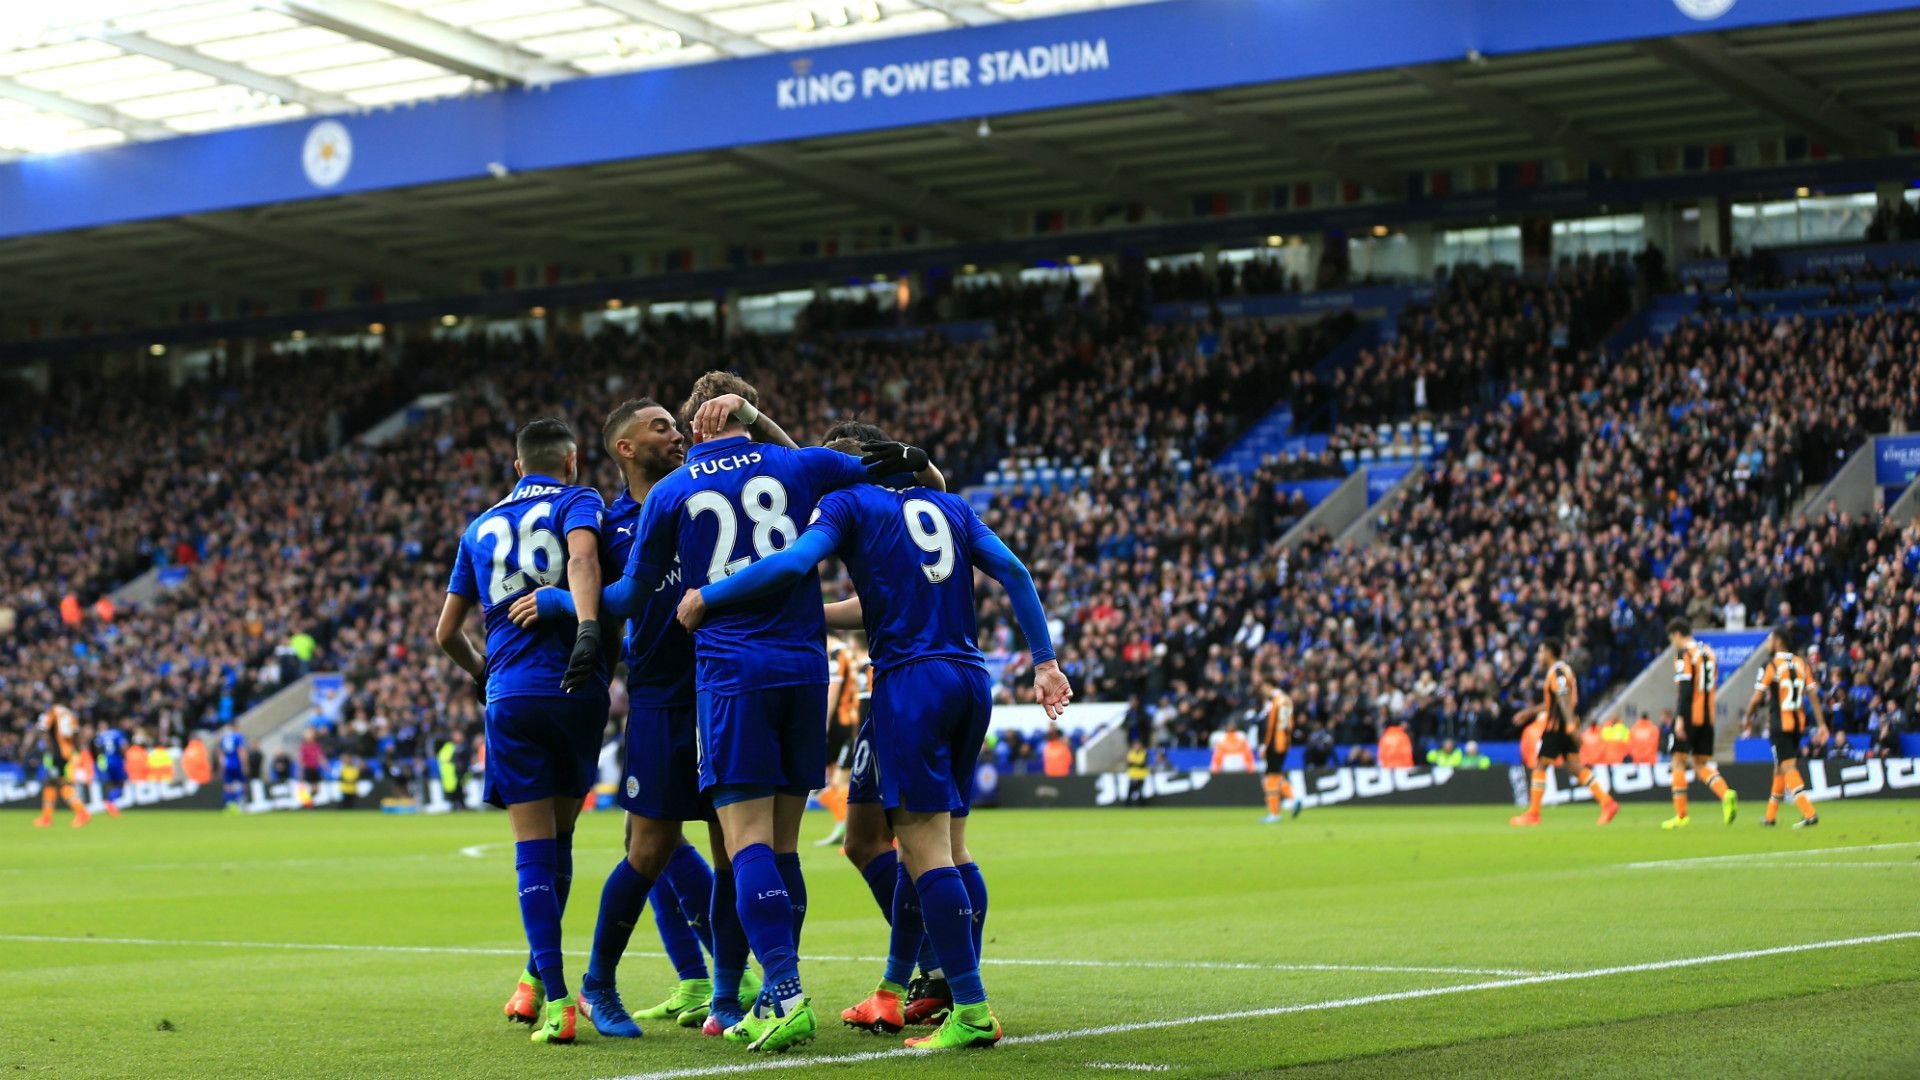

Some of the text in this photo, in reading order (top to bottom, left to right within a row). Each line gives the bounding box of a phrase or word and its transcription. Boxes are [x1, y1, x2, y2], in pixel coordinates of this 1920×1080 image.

[776, 38, 1110, 108] KING POWER STADIUM
[688, 450, 762, 480] FUCHS
[476, 501, 564, 606] 26
[685, 475, 799, 585] 28
[902, 498, 956, 584] 9
[758, 889, 788, 900] LCFC
